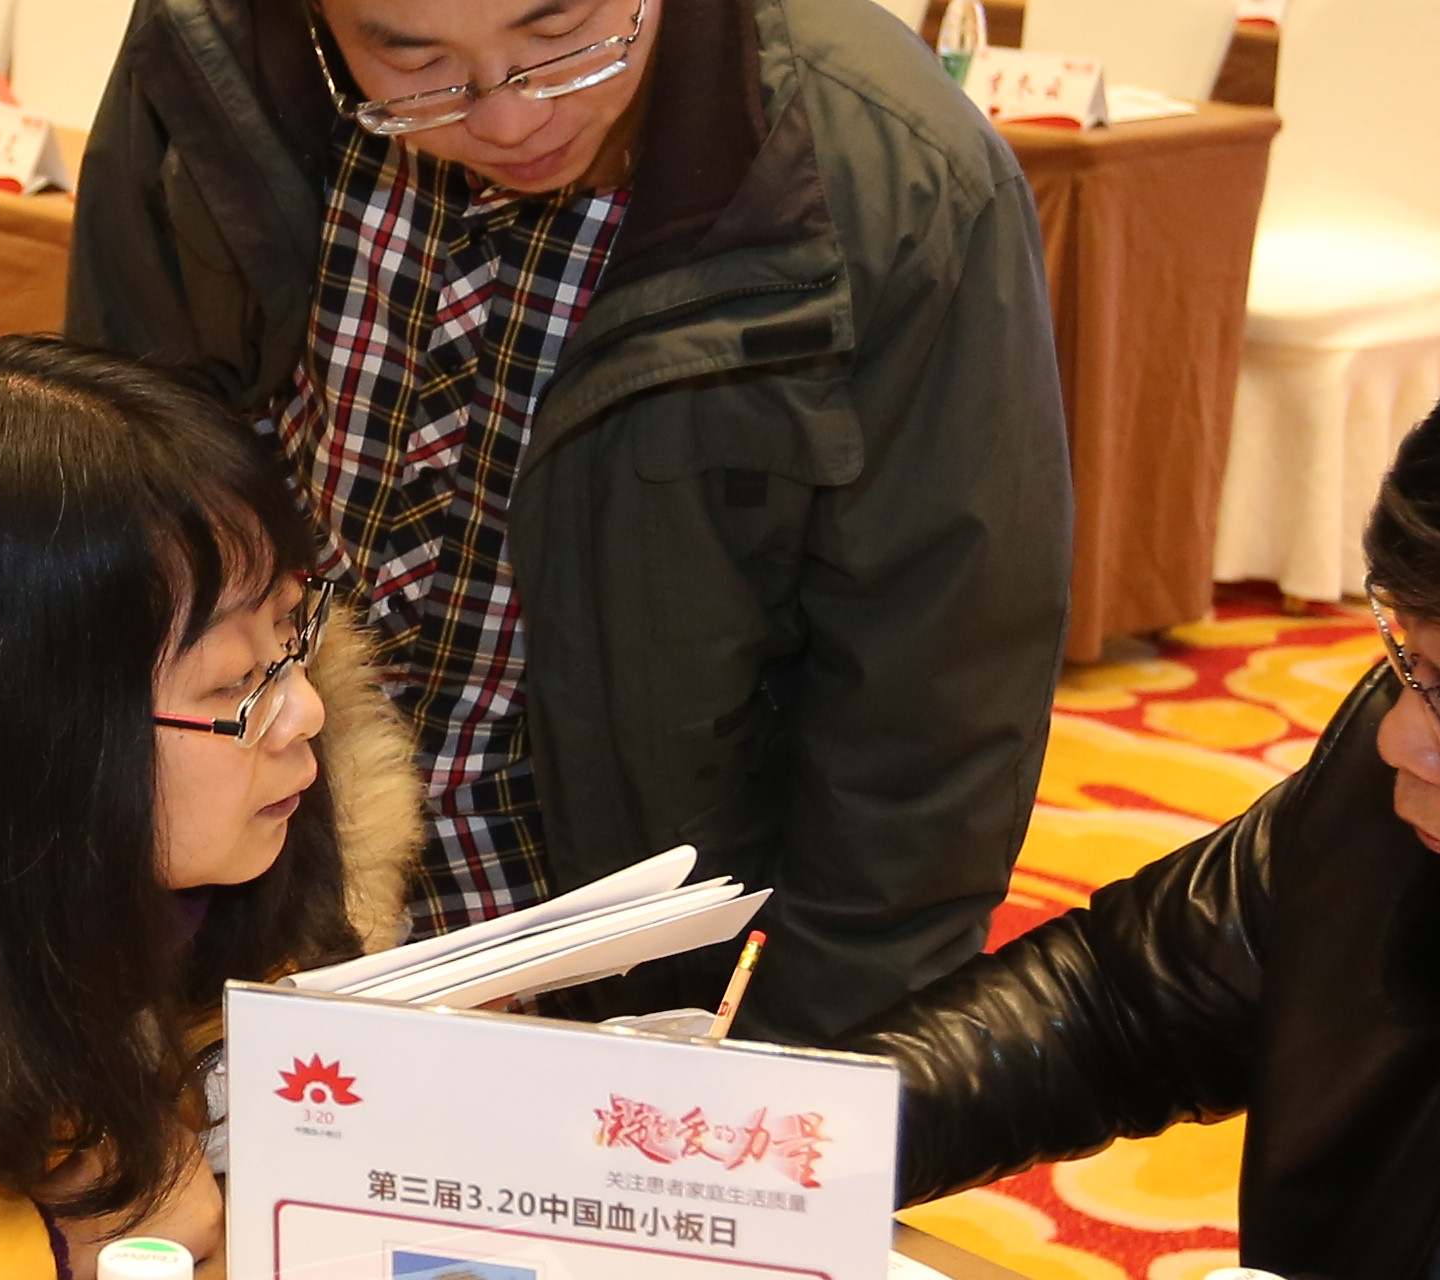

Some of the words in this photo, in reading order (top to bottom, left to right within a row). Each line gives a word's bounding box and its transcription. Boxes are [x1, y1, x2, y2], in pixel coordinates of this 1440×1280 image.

[367, 1169, 737, 1248] 第三届3.20中国血小板日
[605, 1170, 807, 1213] 关注患者家庭生活质量
